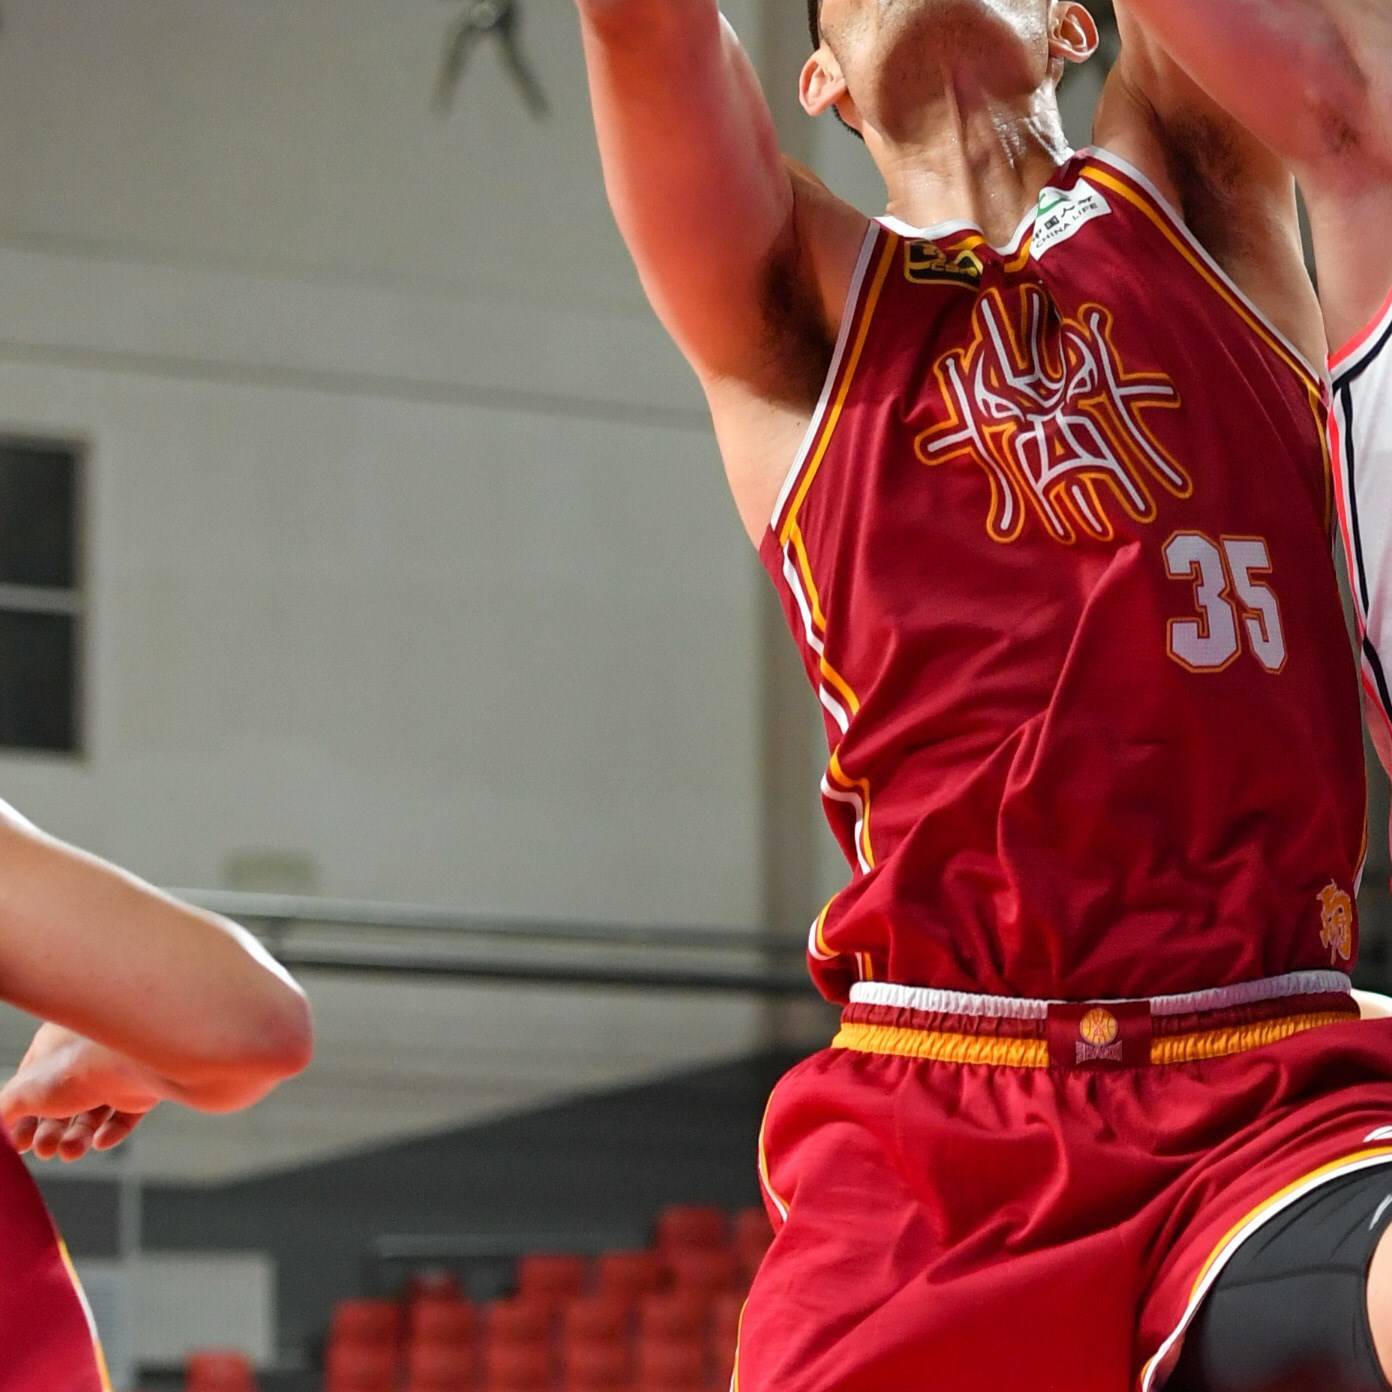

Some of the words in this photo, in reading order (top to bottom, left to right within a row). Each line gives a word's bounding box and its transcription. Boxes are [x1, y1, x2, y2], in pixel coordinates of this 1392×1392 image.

[1036, 222, 1070, 249] CHINA
[1072, 202, 1098, 221] LIFE
[1161, 529, 1287, 674] 35
